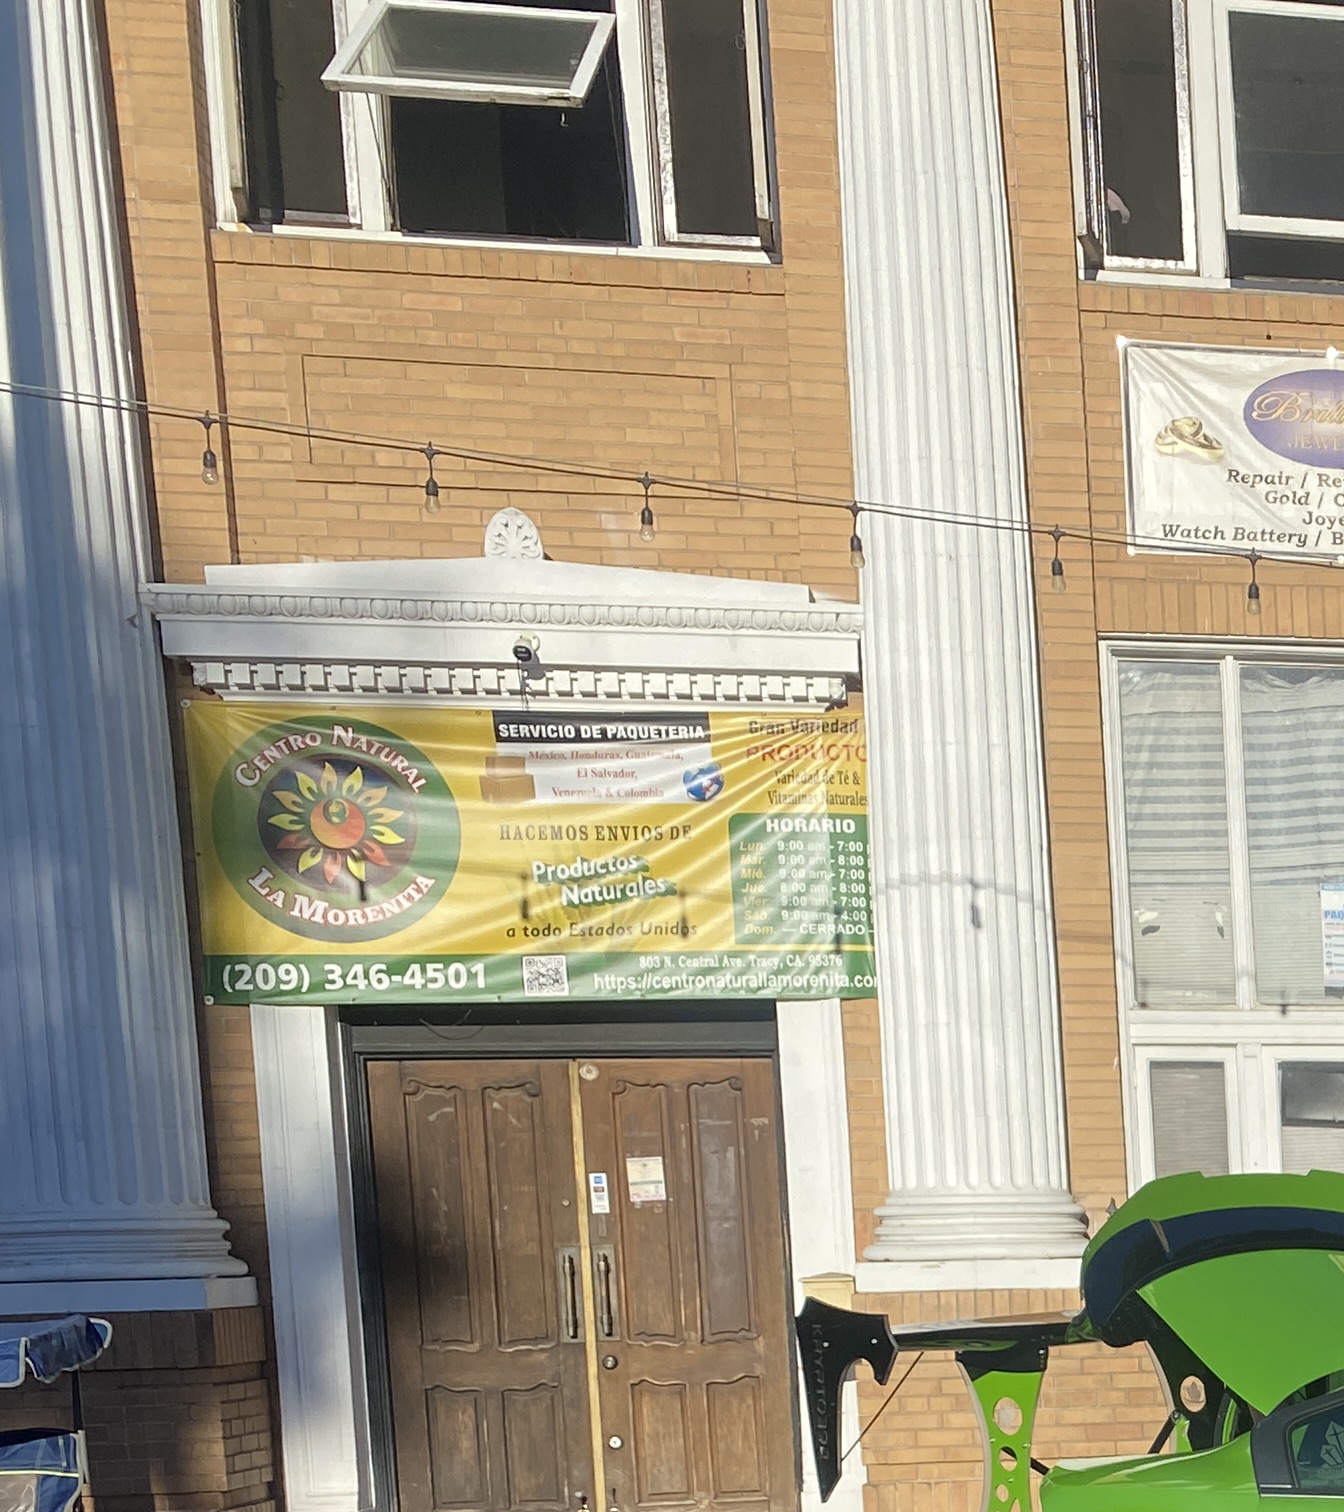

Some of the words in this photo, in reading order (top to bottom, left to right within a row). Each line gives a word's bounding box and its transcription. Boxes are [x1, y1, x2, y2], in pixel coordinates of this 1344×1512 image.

[1226, 469, 1295, 488] Repair
[1300, 472, 1308, 489] /
[1264, 490, 1310, 507] Gold
[1317, 492, 1325, 509] /
[1161, 523, 1226, 542] Watch
[1232, 526, 1308, 548] Battery
[499, 724, 576, 739] SERVICIO
[580, 725, 601, 739] DE
[607, 725, 705, 741] PAQUETERIA
[749, 720, 785, 735] Gran
[791, 718, 859, 734] Variedad
[234, 732, 322, 787] CENTRO
[331, 724, 427, 794] NATURAL
[570, 751, 623, 761] Honduras,
[577, 768, 588, 779] El
[591, 768, 638, 780] Salvador,
[837, 770, 849, 785] Té
[852, 773, 860, 785] &
[822, 791, 868, 807] Naturales
[500, 824, 589, 841] HACEMOS
[595, 825, 663, 842] ENVIOS
[670, 825, 692, 840] DE
[766, 818, 856, 834] HORARIO
[777, 840, 804, 851] 9:00
[837, 841, 863, 852] 7:00
[532, 854, 638, 882] Productos
[838, 855, 864, 866] 8:00
[839, 869, 865, 880] 7:00
[248, 866, 284, 909] LA
[290, 874, 436, 926] MORENITA
[561, 875, 667, 906] Naturales
[839, 883, 865, 893] 8:00
[840, 897, 866, 907] 7:00
[841, 911, 867, 921] 4:00
[506, 927, 515, 937] a
[523, 922, 562, 937] todo
[569, 922, 633, 937] Estados
[641, 921, 698, 938] Unidos
[800, 924, 865, 935] CERRADO
[639, 955, 661, 969] 803
[664, 956, 676, 968] N.
[679, 955, 720, 969] Central
[722, 955, 746, 969] Ave.
[750, 955, 783, 971] Tracy,
[808, 954, 843, 969] 95376
[222, 963, 310, 993] (209)
[323, 962, 486, 992] 346-4501
